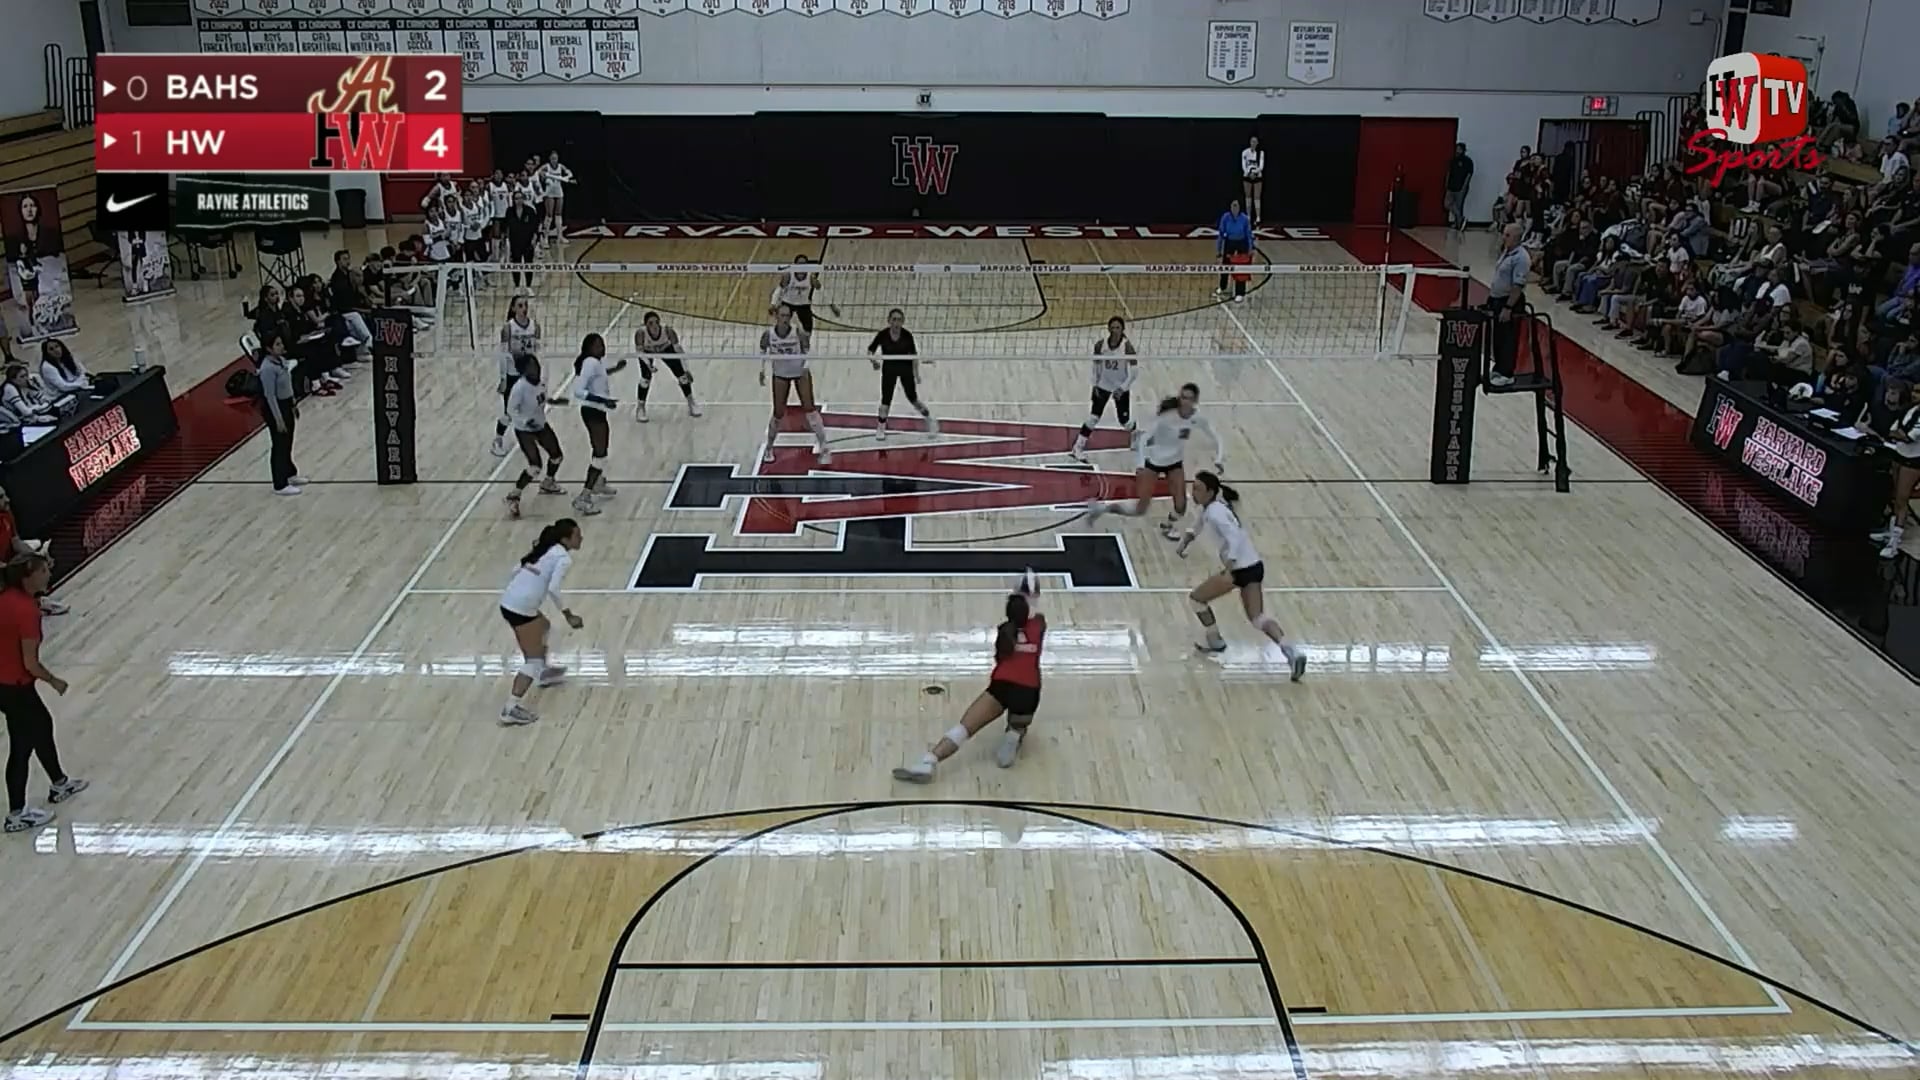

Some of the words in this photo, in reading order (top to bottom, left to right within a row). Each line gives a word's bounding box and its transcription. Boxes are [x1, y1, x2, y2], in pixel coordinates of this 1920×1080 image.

[891, 136, 959, 195] HW
[64, 404, 128, 464] HARVARD
[1445, 358, 1470, 481] WESTLAKE
[1706, 393, 1744, 450] HW
[1752, 416, 1826, 476] HARVARD
[69, 424, 142, 491] WESTLAKE
[1741, 437, 1824, 507] WESTLAKE
